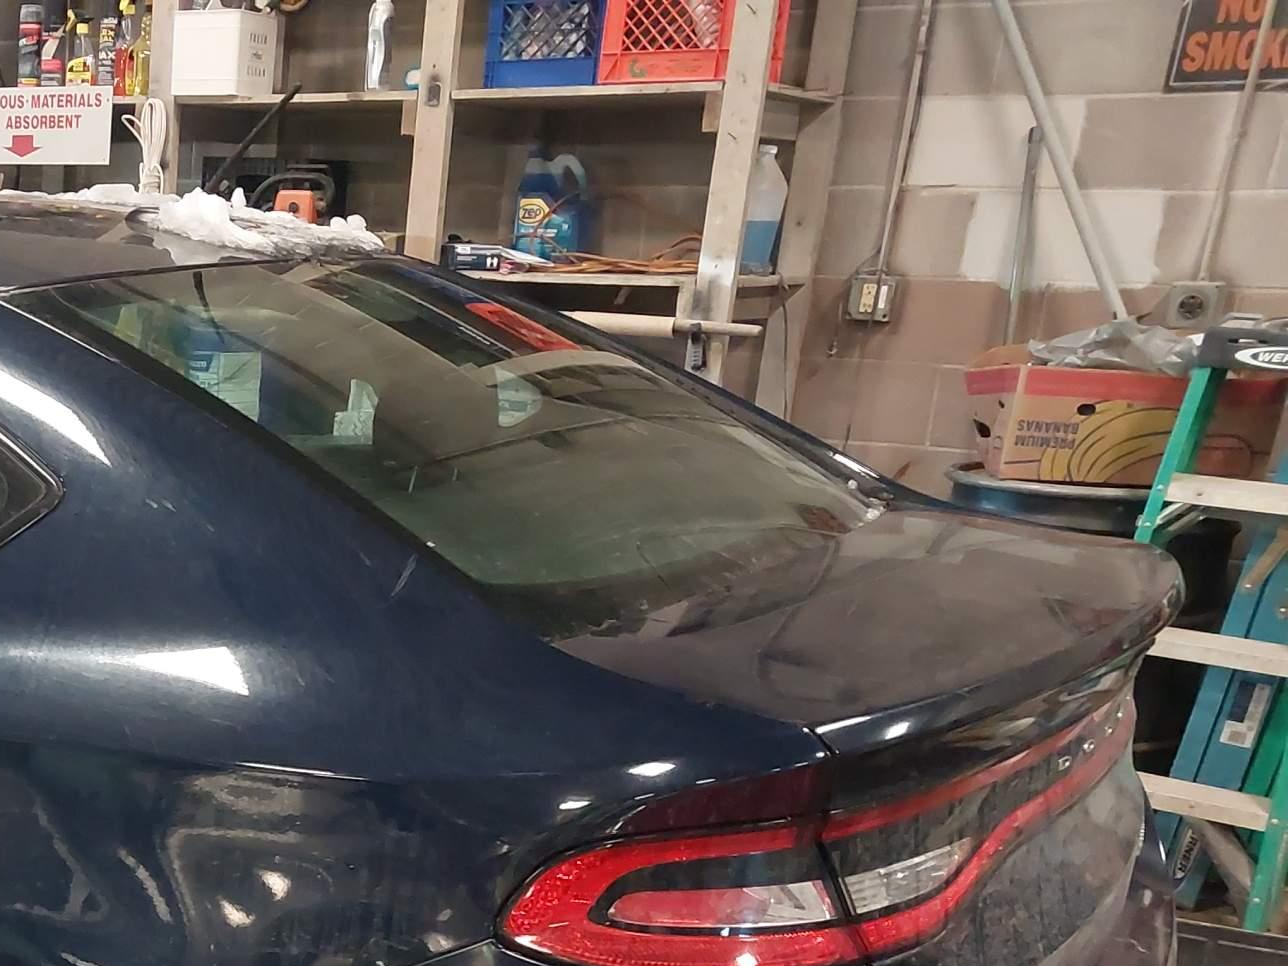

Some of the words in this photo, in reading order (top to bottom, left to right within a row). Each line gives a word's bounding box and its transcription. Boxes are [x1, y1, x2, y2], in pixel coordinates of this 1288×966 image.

[1182, 29, 1288, 72] SMOK
[31, 92, 103, 109] MATERIALS
[6, 114, 82, 130] ABSORBENT
[1017, 419, 1080, 435] BANANAS
[1014, 434, 1076, 450] PREMIUM
